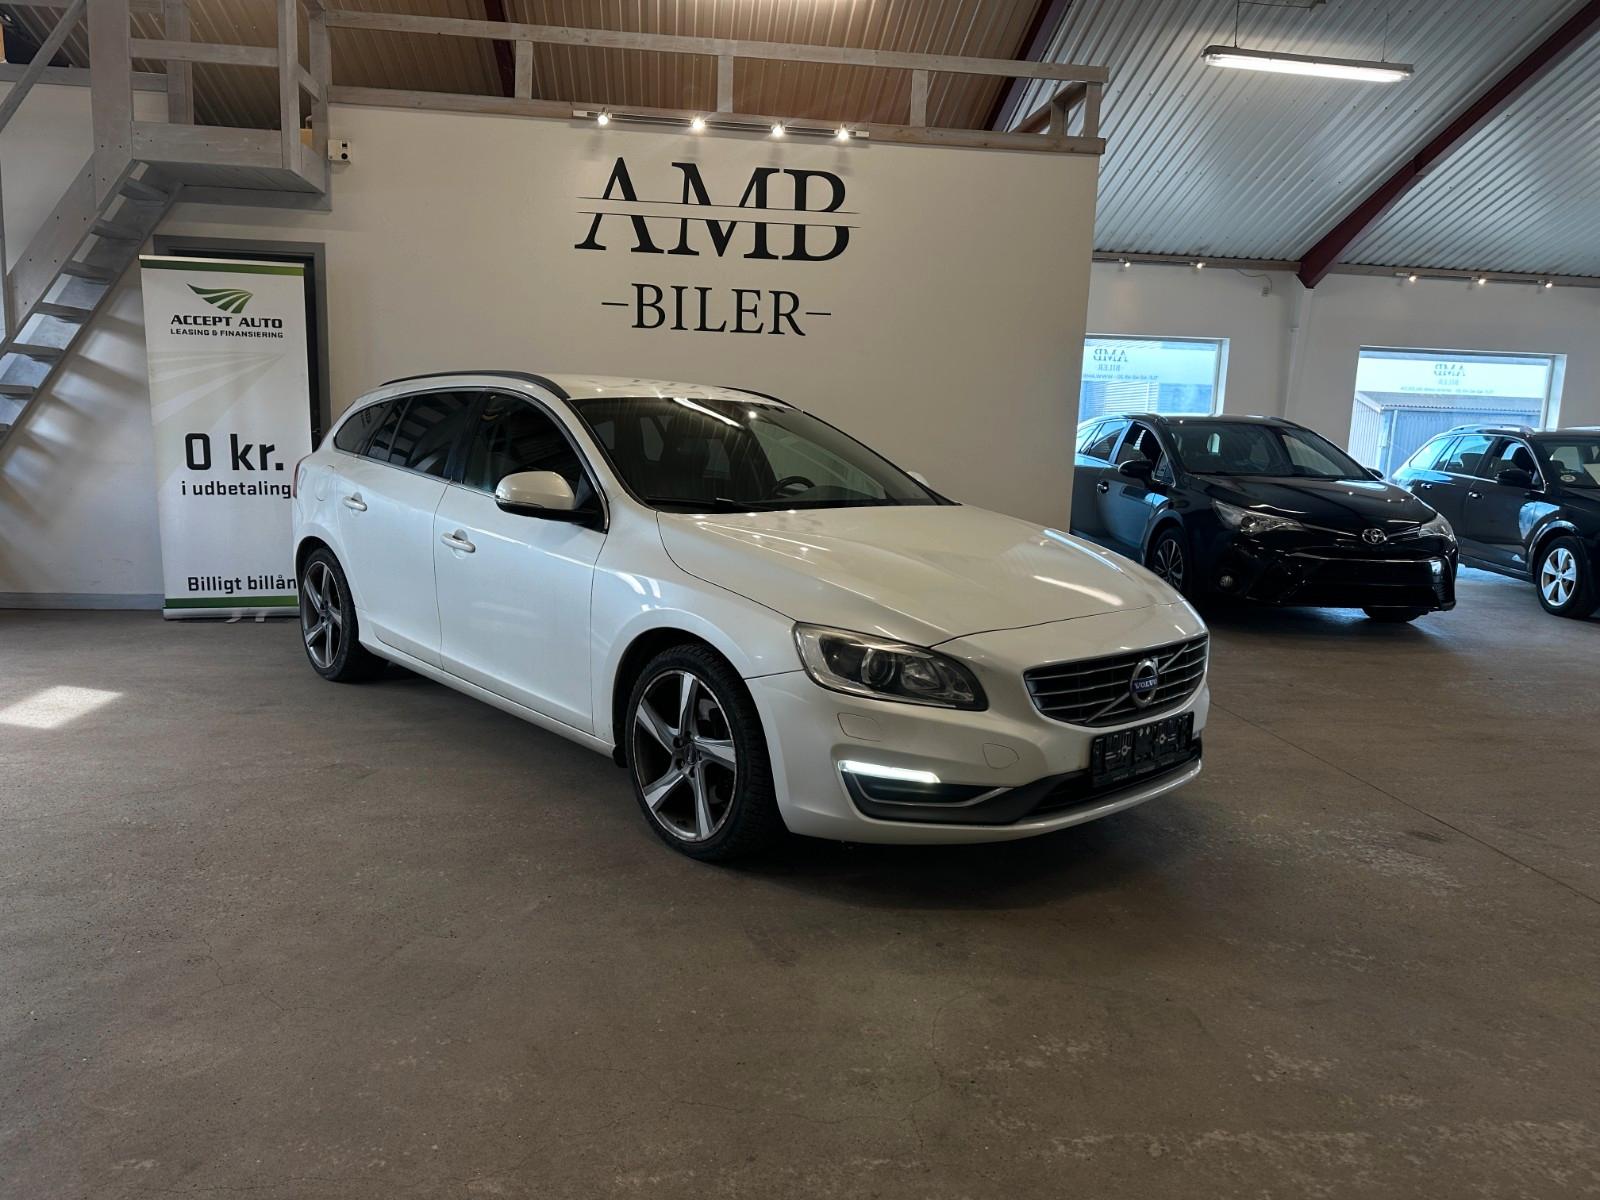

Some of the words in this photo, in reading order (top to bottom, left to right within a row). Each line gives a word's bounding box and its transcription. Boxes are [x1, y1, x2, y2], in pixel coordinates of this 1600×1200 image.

[574, 157, 850, 261] AMB
[631, 283, 806, 336] BILER
[170, 314, 233, 327] ACCEPT
[239, 317, 283, 329] AUTO
[170, 328, 210, 336] LEASING
[211, 329, 218, 337] &
[220, 330, 284, 339] FINANSIERING
[185, 432, 212, 471] 0
[230, 433, 284, 471] kr.
[181, 480, 186, 496] i
[193, 480, 291, 499] udbetaling
[187, 576, 242, 594] Billigt
[247, 574, 297, 590] billån
